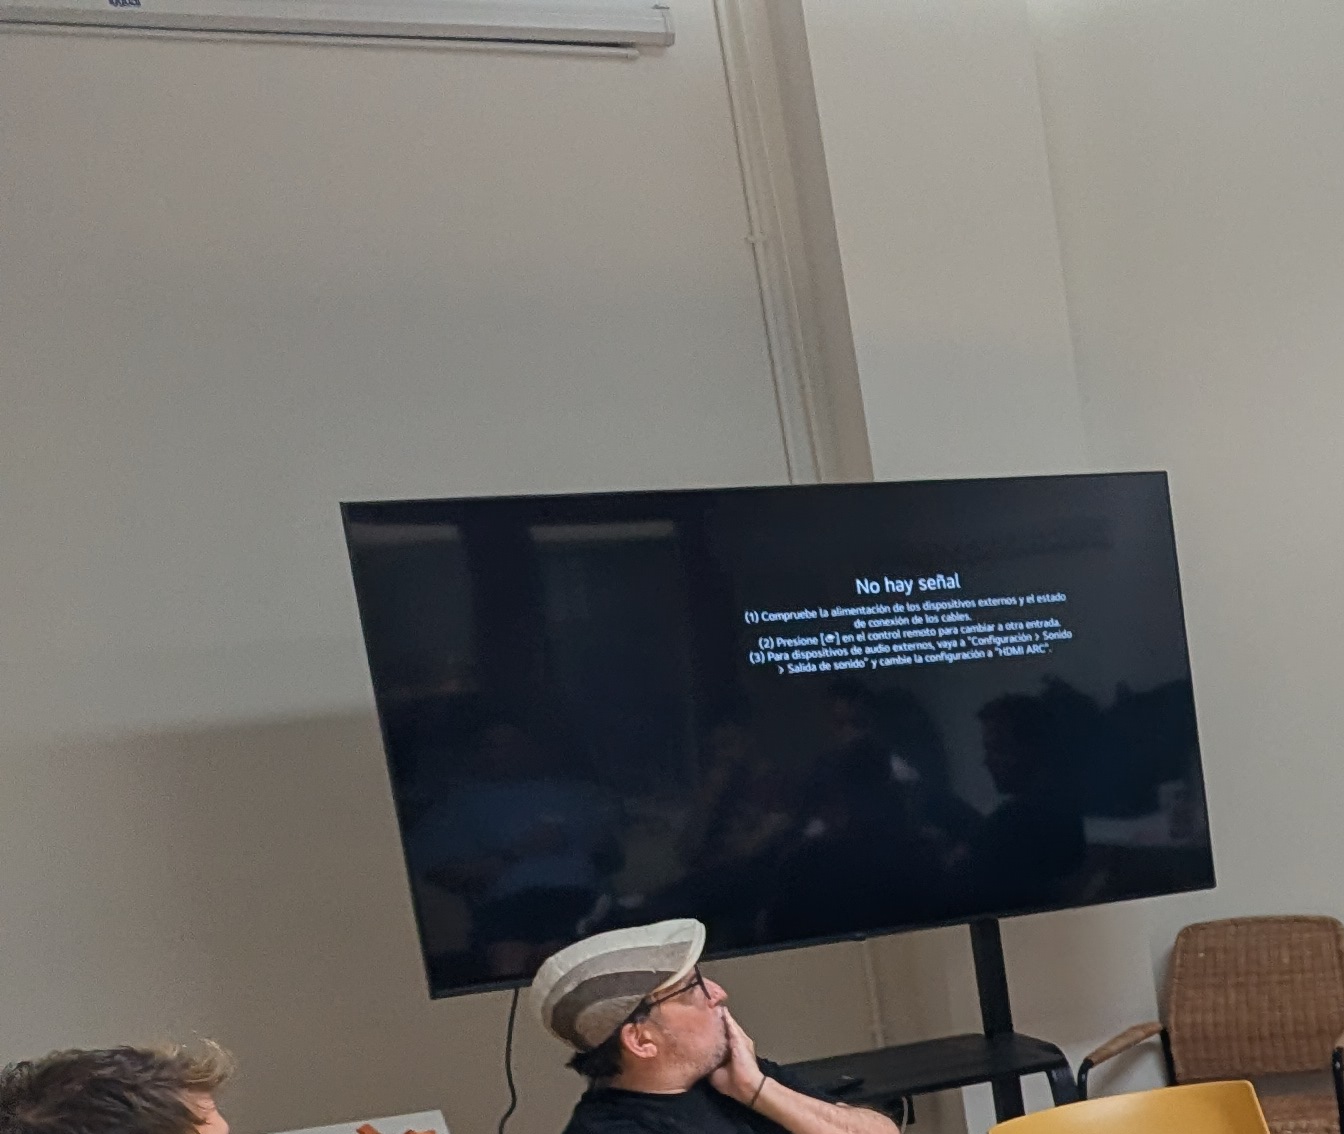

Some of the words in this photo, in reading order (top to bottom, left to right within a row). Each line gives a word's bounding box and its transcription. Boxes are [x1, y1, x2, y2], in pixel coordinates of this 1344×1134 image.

[856, 578, 880, 595] No
[884, 576, 913, 596] hay
[918, 572, 961, 591] señal
[744, 611, 759, 624] (1)
[761, 608, 817, 622] Compruebe
[819, 607, 829, 618] la
[831, 603, 891, 617] alimentación
[893, 603, 905, 613] de
[906, 602, 921, 612] los
[922, 599, 976, 612] dispositivos
[977, 596, 1017, 607] externos
[1019, 597, 1025, 607] y
[1026, 593, 1035, 604] el
[1036, 592, 1067, 603] estado
[854, 619, 866, 629] de
[868, 615, 910, 628] conexión
[911, 614, 923, 625] de
[925, 614, 939, 624] los
[941, 611, 972, 622] cables.
[749, 651, 765, 665] (3)
[767, 650, 790, 662] Para
[791, 647, 849, 661] dispositivos
[850, 645, 863, 656] de
[864, 643, 890, 655] audio
[892, 641, 936, 653] externos,
[936, 639, 958, 650] vaya
[959, 639, 966, 648] a
[1042, 629, 1073, 641] Sonido
[759, 636, 774, 650] (2)
[776, 635, 818, 647] Presione
[841, 633, 855, 643] en
[856, 631, 866, 642] el
[868, 629, 901, 641] control
[903, 628, 937, 638] remoto
[938, 627, 959, 637] para
[960, 623, 995, 634] cambiar
[997, 623, 1004, 631] a
[1005, 621, 1024, 631] otra
[1025, 617, 1062, 629] entrada.
[787, 662, 817, 674] Salida
[818, 660, 832, 671] de
[870, 659, 878, 669] y
[879, 654, 912, 666] cambie
[914, 653, 924, 664] la
[925, 650, 985, 664] configuración
[986, 649, 994, 658] a
